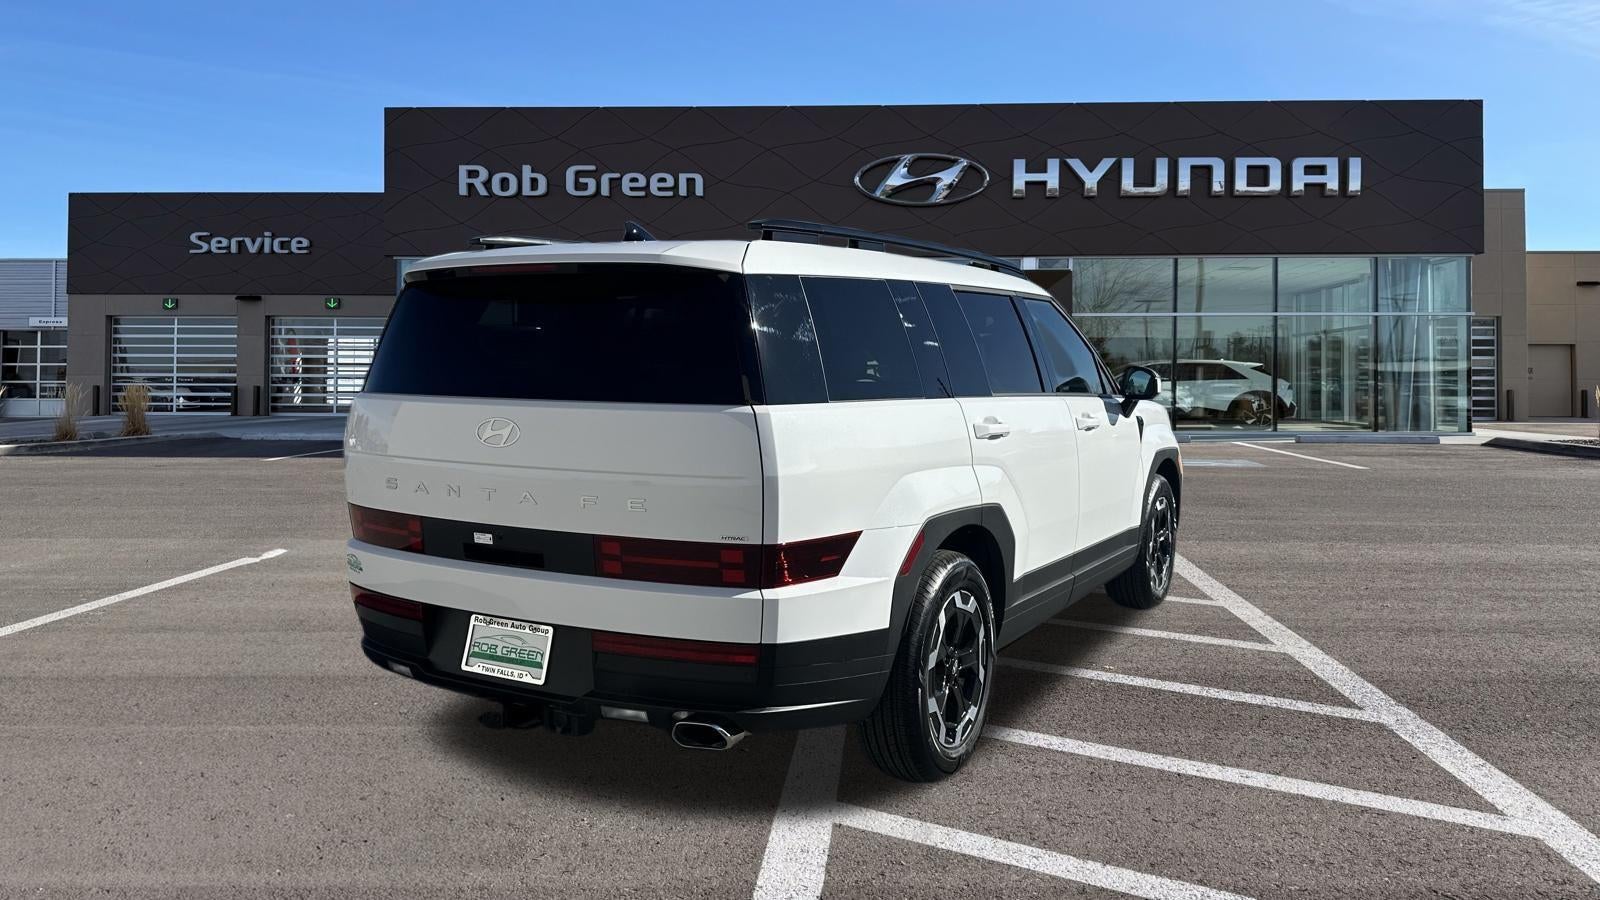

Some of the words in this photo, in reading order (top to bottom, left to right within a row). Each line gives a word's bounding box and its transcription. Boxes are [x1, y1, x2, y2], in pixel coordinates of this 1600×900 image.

[458, 164, 548, 197] Rob
[565, 164, 704, 197] Green
[1011, 157, 1362, 198] HYUNDAI
[189, 231, 311, 254] Service
[385, 477, 538, 506] SANTA
[580, 495, 648, 513] FE
[474, 615, 488, 625] Rob
[488, 618, 509, 628] Green
[510, 621, 527, 631] Auto
[528, 624, 550, 635] Group
[472, 641, 499, 654] ROB
[501, 645, 545, 662] GREEN
[481, 665, 496, 674] TWIN
